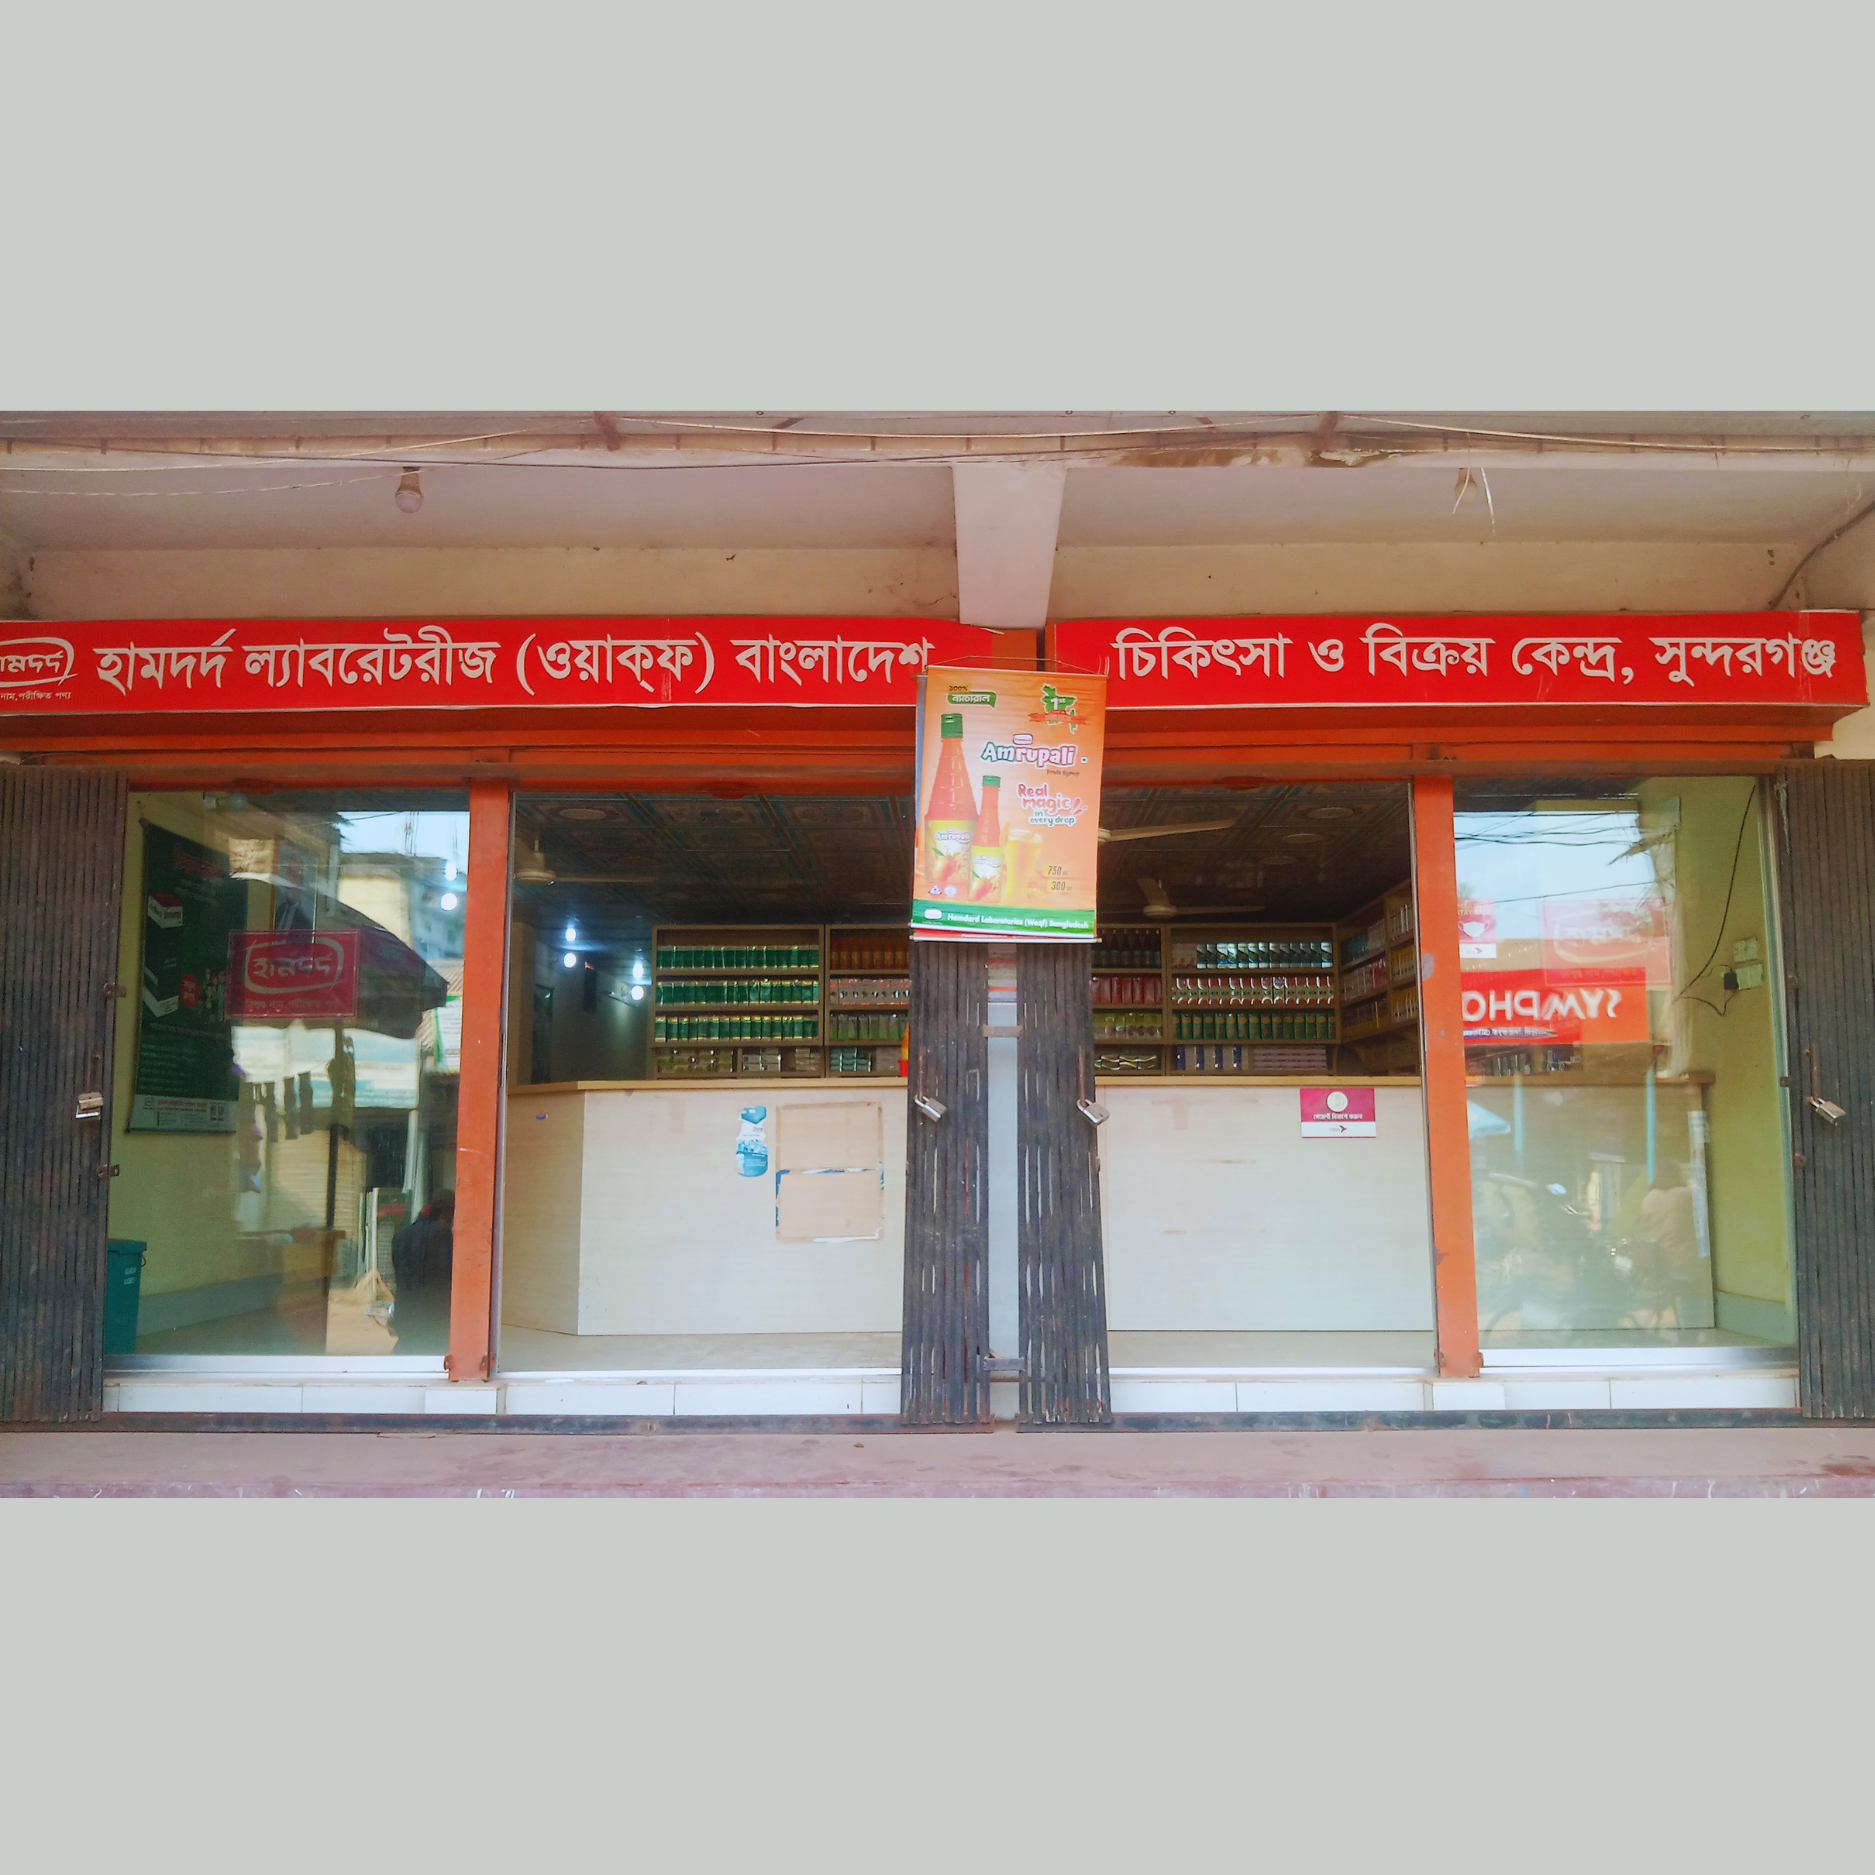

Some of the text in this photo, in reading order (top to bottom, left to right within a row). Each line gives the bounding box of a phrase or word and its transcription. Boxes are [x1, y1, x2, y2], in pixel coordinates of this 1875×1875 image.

[0, 650, 64, 673] ামদর্দ
[93, 628, 237, 696] হামদর্দ
[243, 625, 501, 688] ল্যাবরেটরীজ
[730, 633, 936, 686] বাংলাদেশ
[1110, 623, 1836, 687] চিকিৎসা ও বিক্রয় কেন্দ্র, সুন্দরগঞ্জ
[980, 741, 1077, 768] Amrupali
[1018, 783, 1048, 798] Real
[1022, 793, 1072, 814] magic
[1029, 815, 1075, 827] every drop
[1048, 865, 1062, 876] 750
[1051, 880, 1066, 891] 300
[947, 913, 980, 923] Hamdard
[981, 915, 1024, 926] Laboratories
[1049, 918, 1089, 930] Bangladesh
